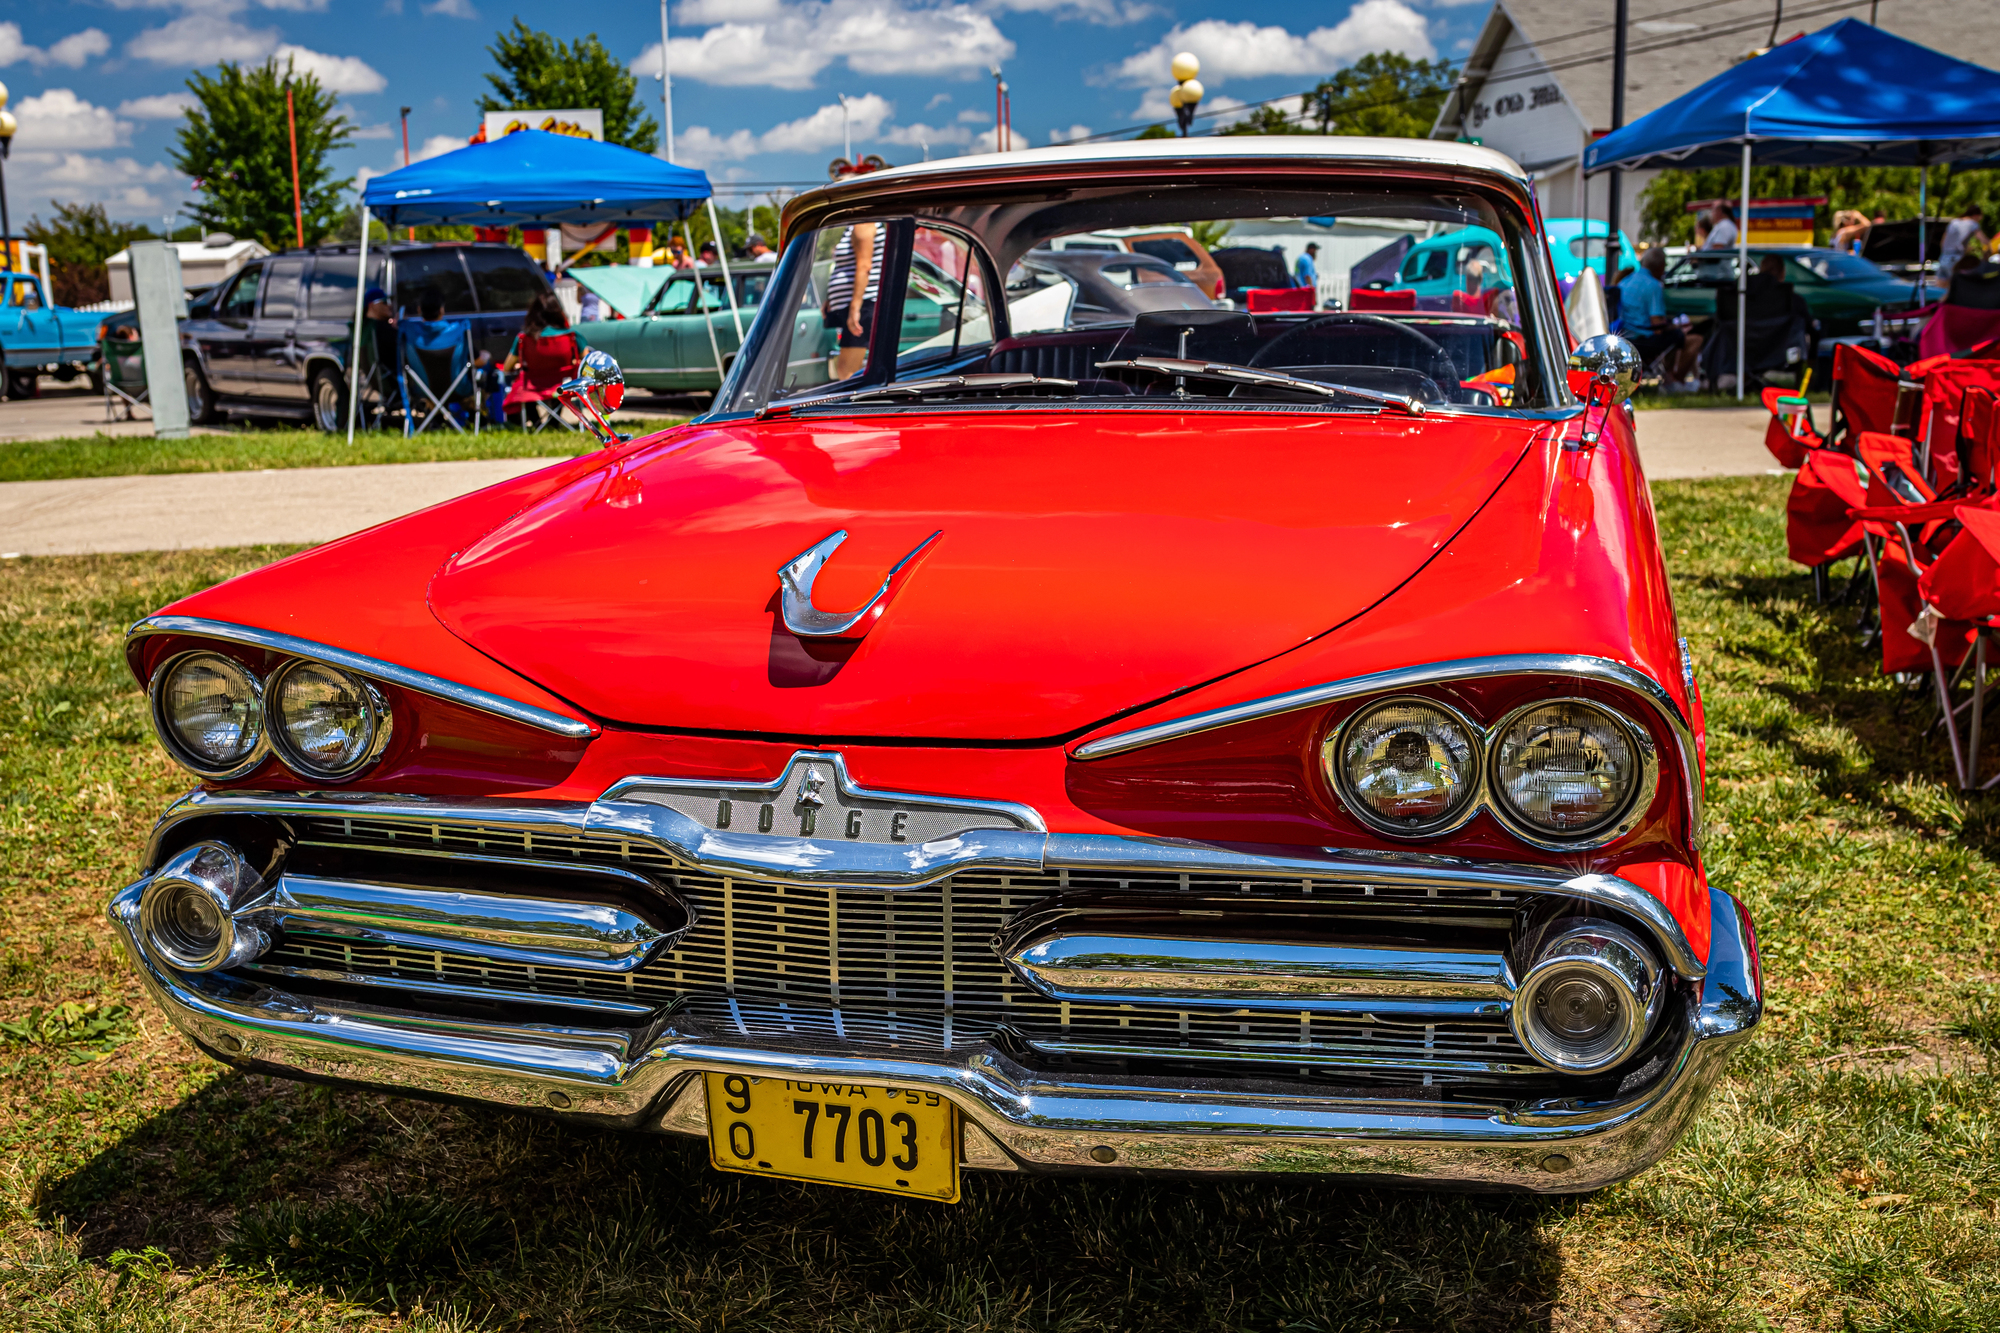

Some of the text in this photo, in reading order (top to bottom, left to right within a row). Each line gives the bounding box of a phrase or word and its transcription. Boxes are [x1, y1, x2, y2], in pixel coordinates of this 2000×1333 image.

[1473, 101, 1491, 129] Ye
[1495, 92, 1524, 117] Old
[717, 799, 908, 842] DODGE
[793, 1100, 918, 1171] 7703
